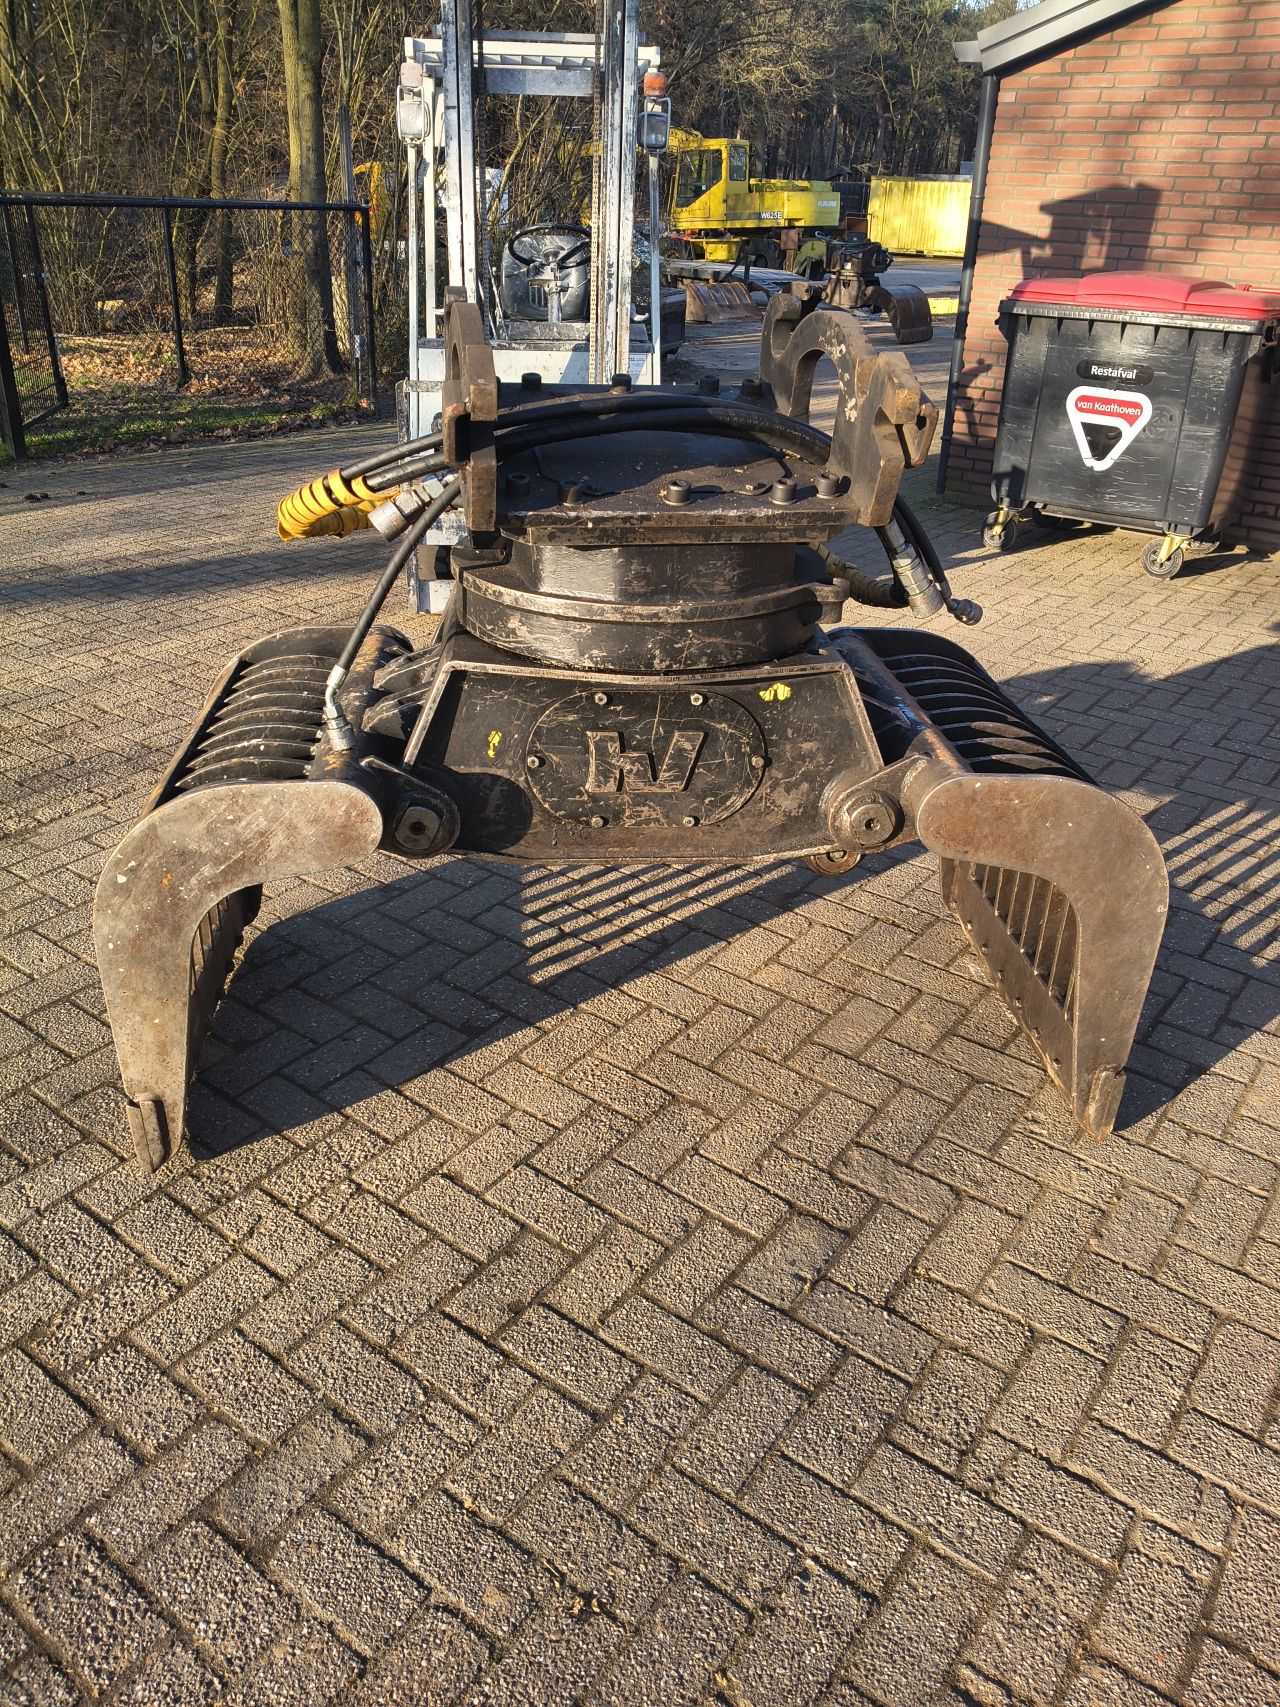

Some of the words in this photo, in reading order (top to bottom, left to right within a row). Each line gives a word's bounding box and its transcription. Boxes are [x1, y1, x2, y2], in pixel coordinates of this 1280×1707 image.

[1090, 365, 1137, 380] Restafval
[1077, 400, 1093, 410] van
[1094, 402, 1141, 416] Kaathoven
